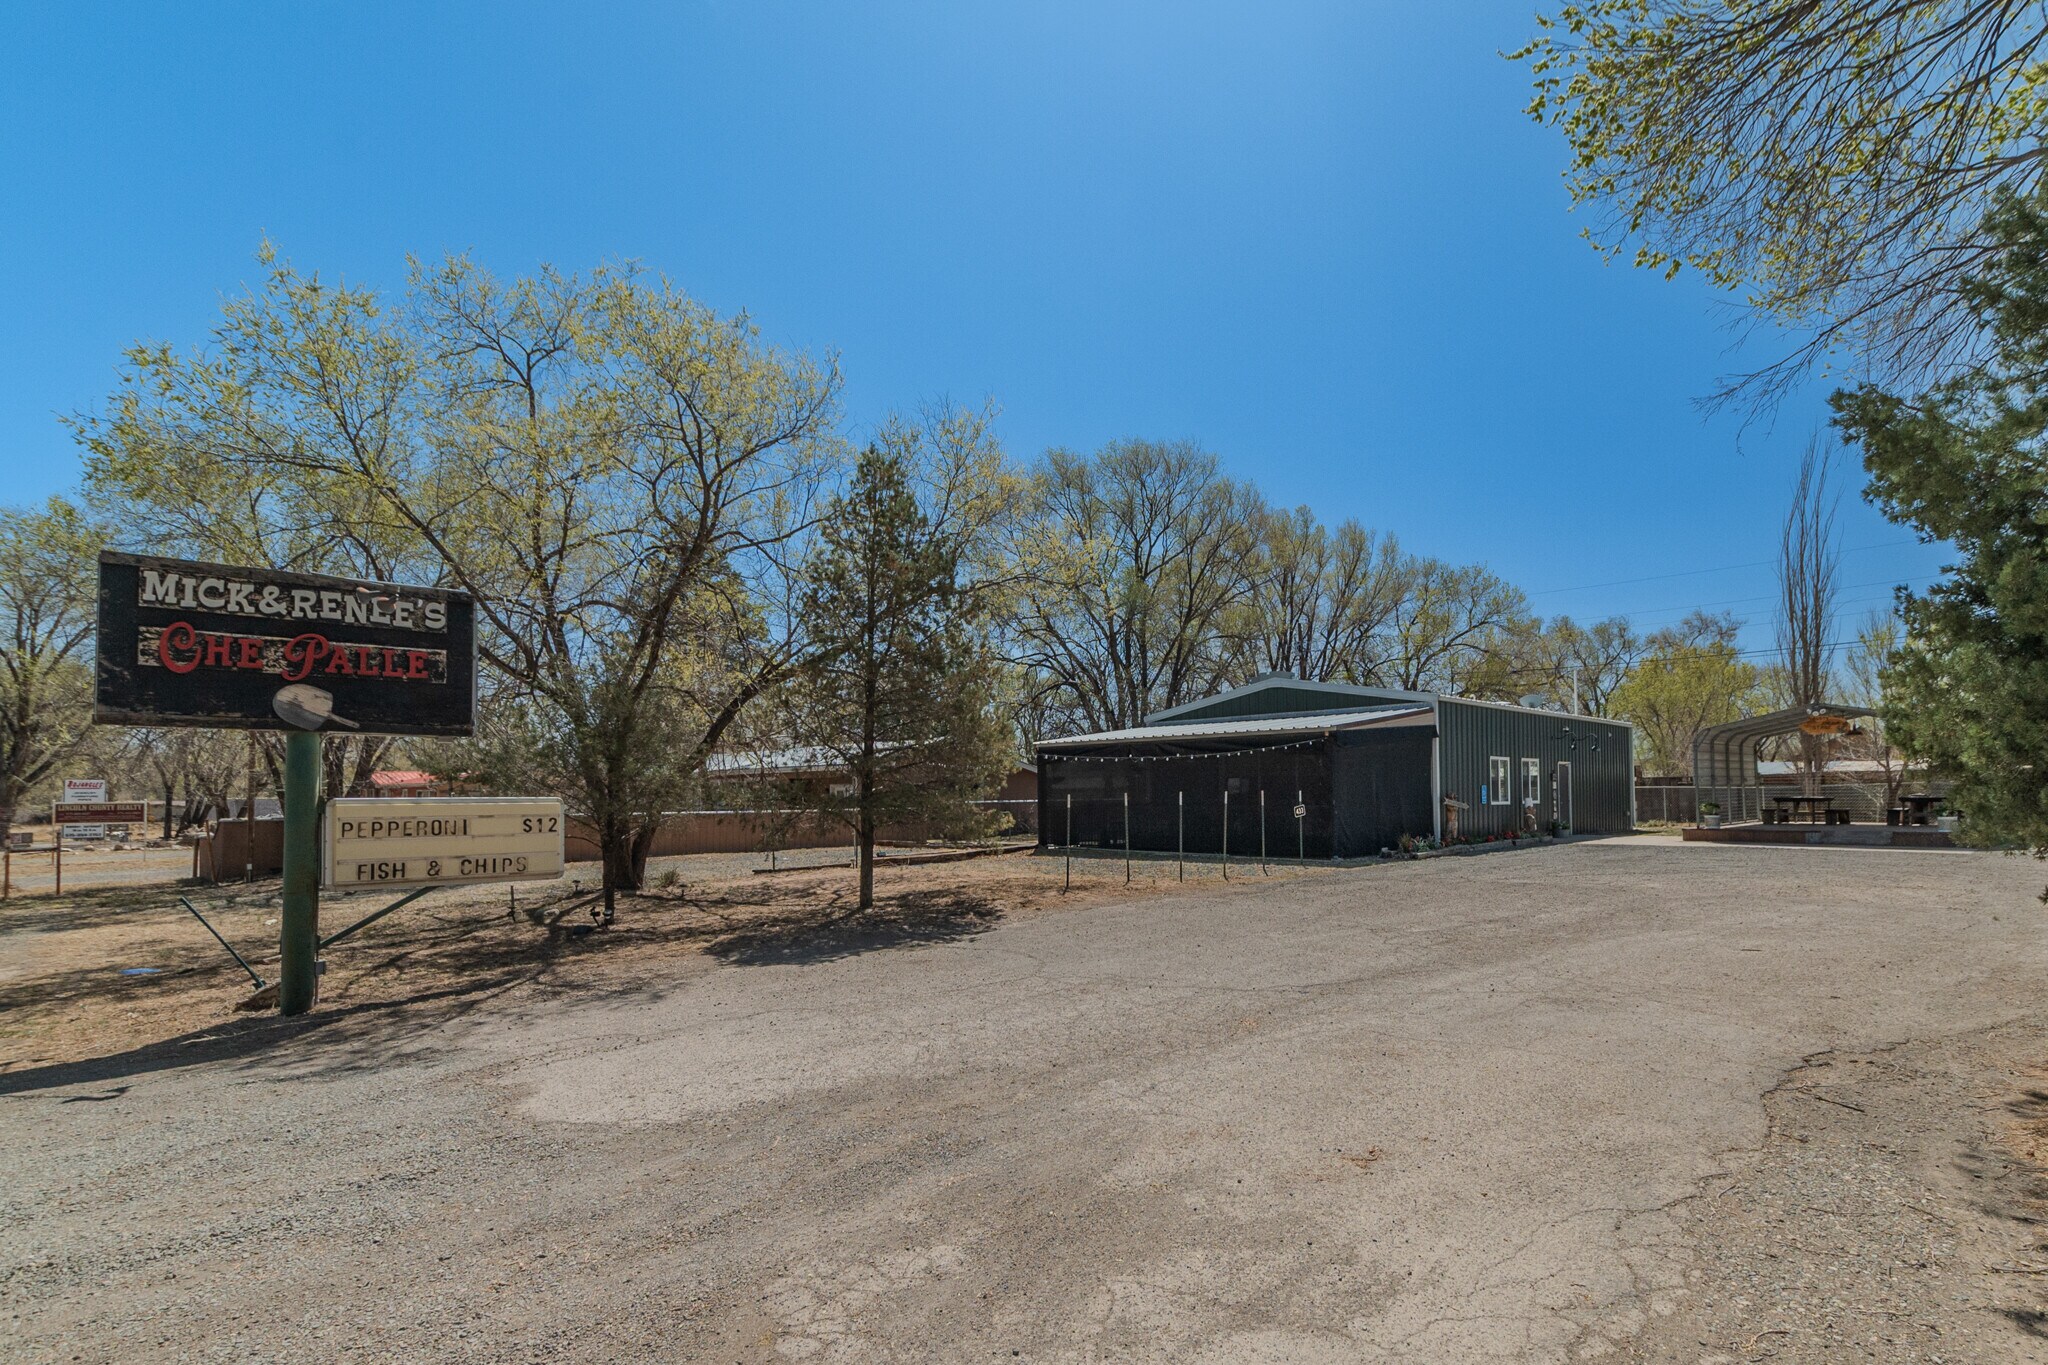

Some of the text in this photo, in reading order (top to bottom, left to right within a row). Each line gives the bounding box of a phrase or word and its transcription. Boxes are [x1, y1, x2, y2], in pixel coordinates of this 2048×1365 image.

[159, 621, 429, 681] CHE PALLE
[341, 819, 468, 838] PEPPERONI
[357, 857, 528, 880] FISH & CHIPS
